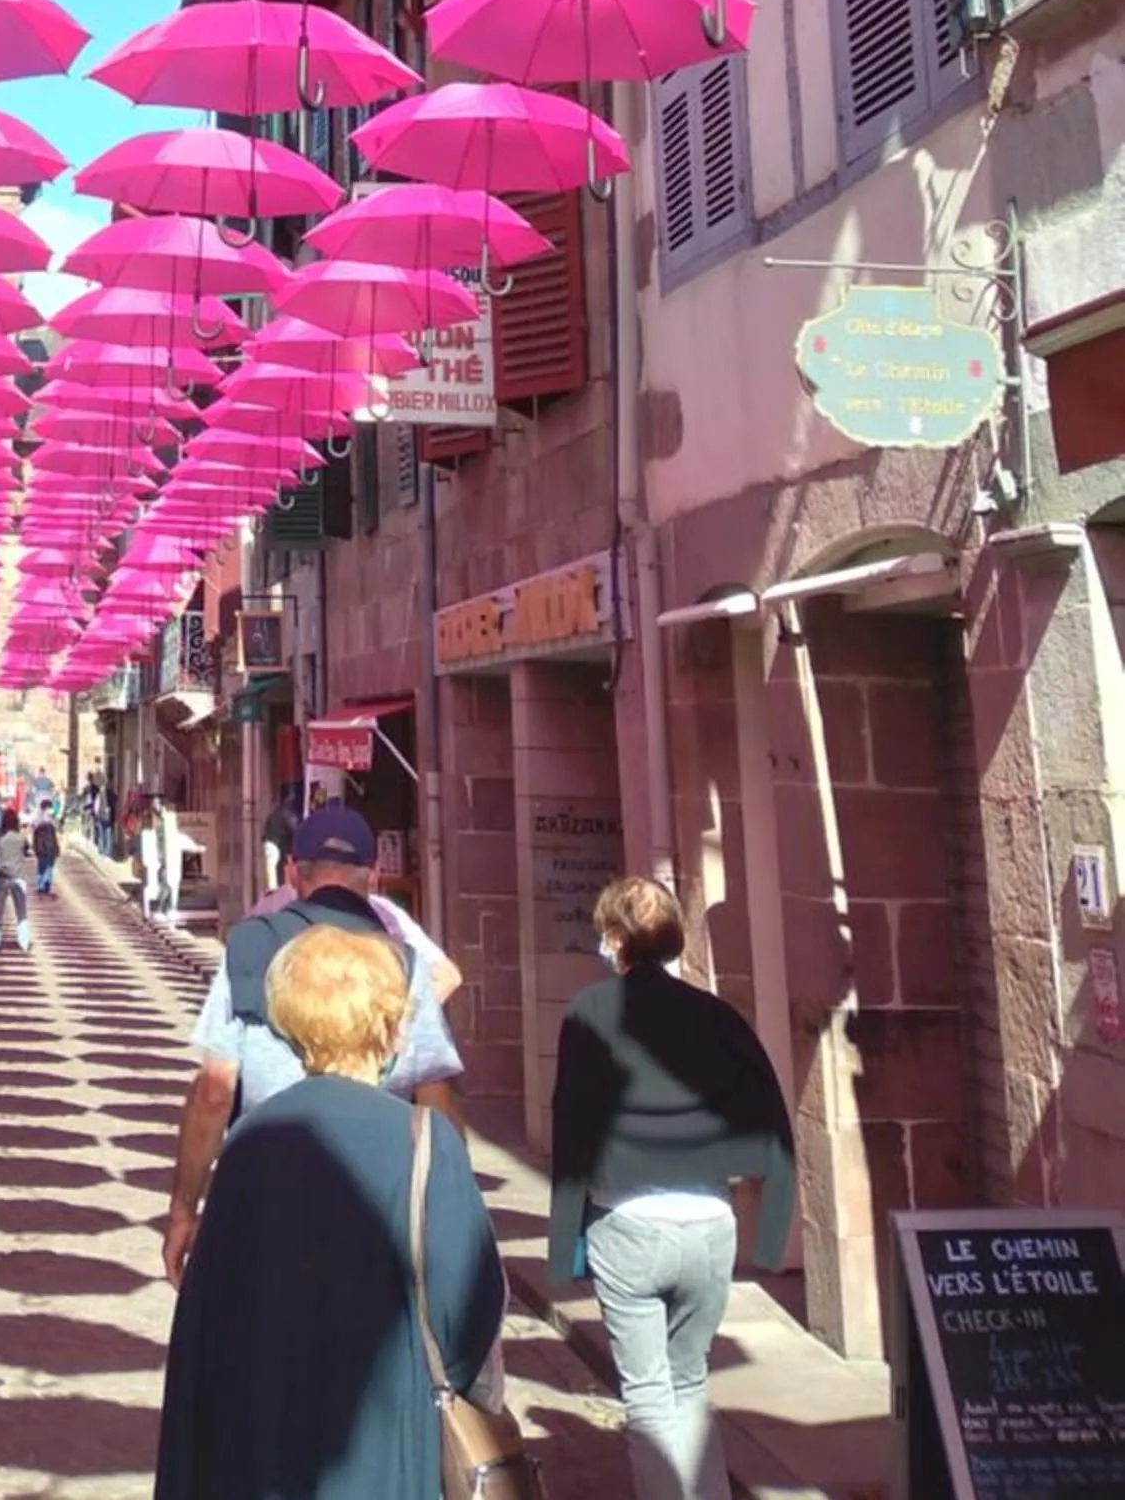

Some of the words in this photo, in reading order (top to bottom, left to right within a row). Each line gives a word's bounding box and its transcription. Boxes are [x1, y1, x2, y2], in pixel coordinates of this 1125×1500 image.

[427, 354, 484, 385] THÉ
[945, 1239, 977, 1262] LE
[990, 1237, 1081, 1261] CHEMIN
[928, 1272, 986, 1296] VERS
[991, 1263, 1100, 1295] L'ÉTOILE
[942, 1308, 1047, 1333] CHECK-IN
